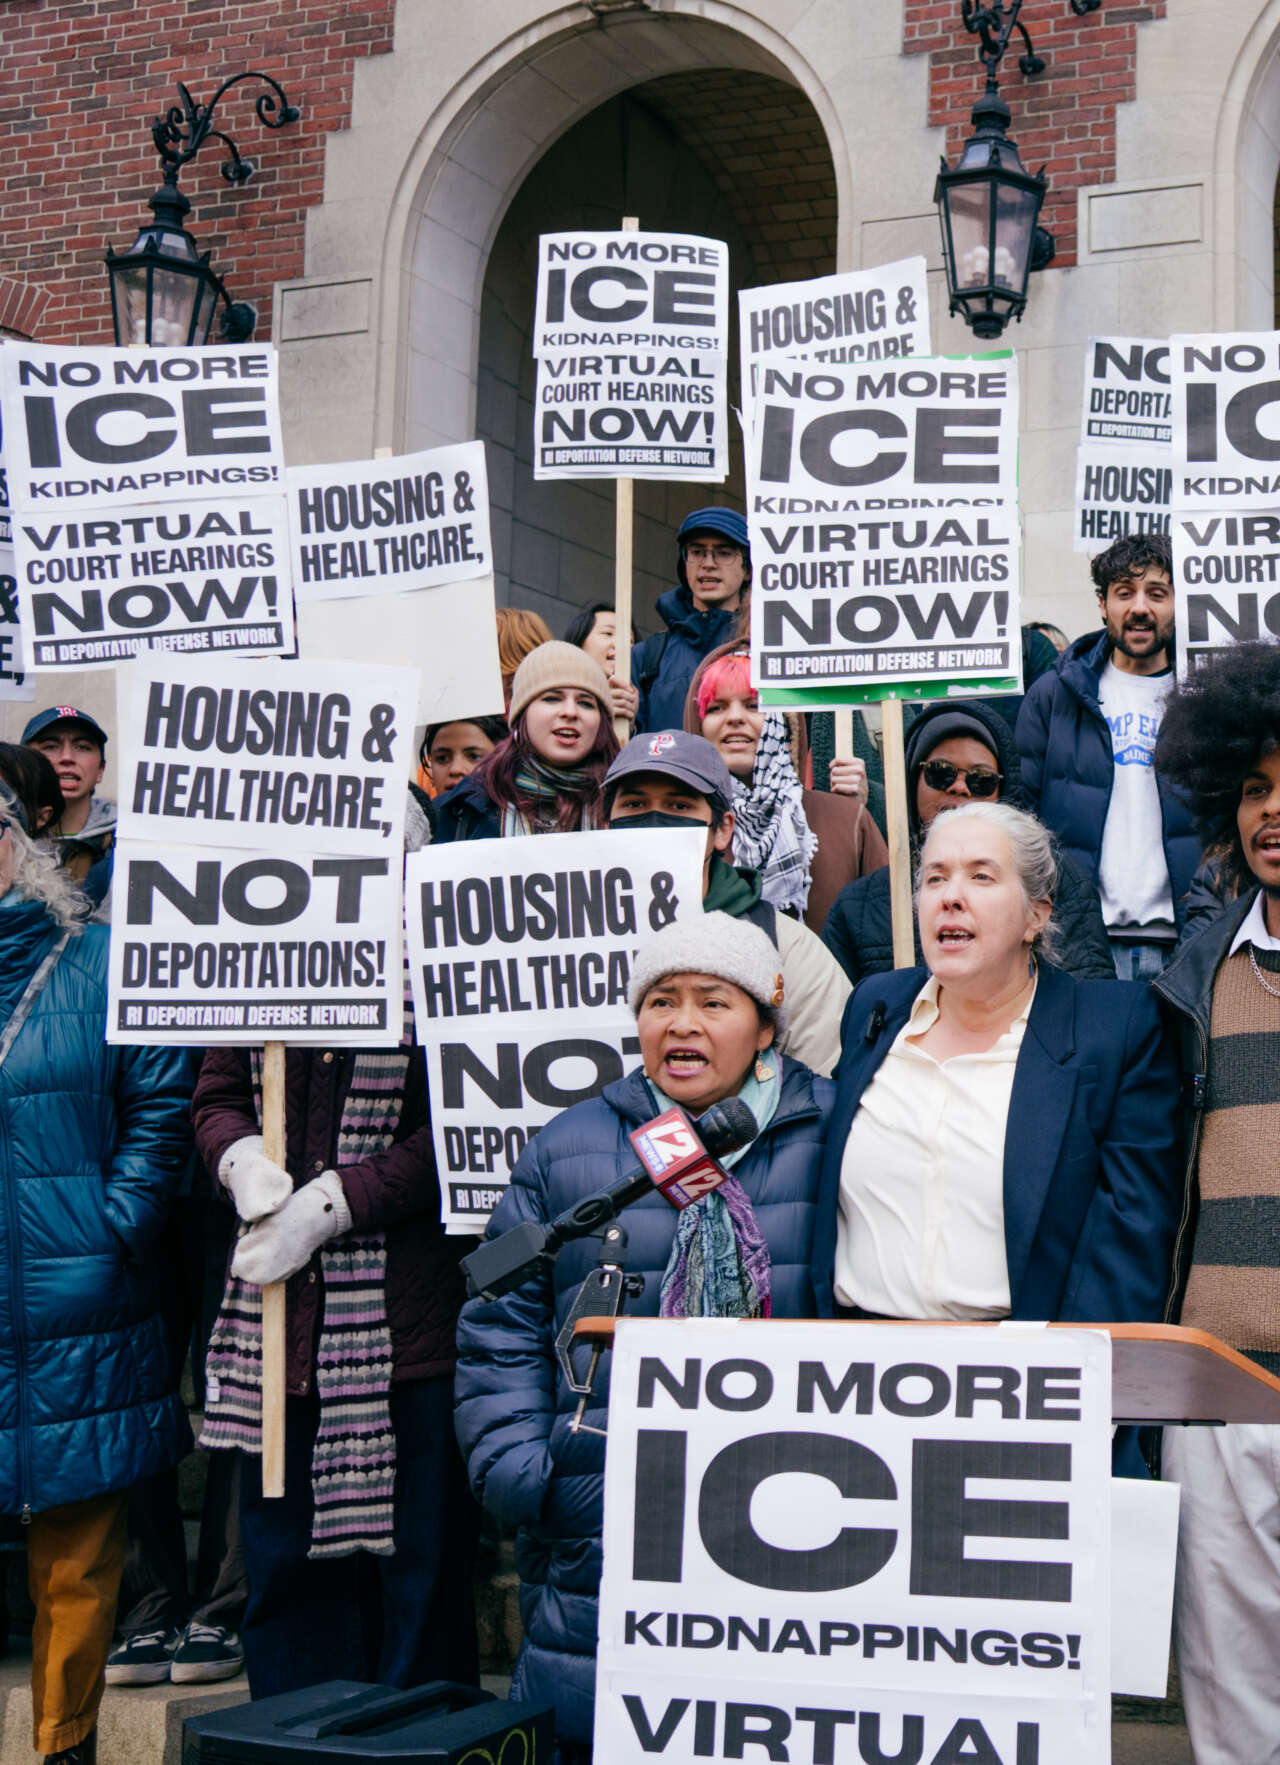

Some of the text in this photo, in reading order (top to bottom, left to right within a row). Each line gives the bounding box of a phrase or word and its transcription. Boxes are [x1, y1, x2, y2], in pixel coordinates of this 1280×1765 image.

[547, 241, 720, 268] NO MORE
[545, 266, 717, 327] ICE
[750, 285, 917, 353] HOUSING &
[542, 332, 720, 350] KIDNAPPINGS!
[1183, 345, 1266, 373] NO
[19, 354, 269, 388] NO MORE
[544, 355, 715, 379] VIRTUAL
[764, 368, 845, 402] NO
[856, 370, 1008, 401] MORE
[1093, 342, 1171, 385] NO
[542, 382, 714, 404] COURT HEARINGS
[1089, 388, 1172, 419] DEPORTA
[23, 386, 272, 469] ICE
[542, 407, 715, 444] NOW!
[759, 405, 1002, 487] ICE
[555, 449, 616, 464] DEPORTATION
[619, 449, 661, 463] DEFENSE
[663, 450, 710, 465] NETWORK
[29, 465, 279, 499] KIDNAPPINGS!
[298, 470, 475, 535] HOUSING &
[22, 510, 273, 551] VIRTUAL
[759, 519, 1010, 555] VIRTUAL
[26, 542, 275, 585] COURT HEARINGS
[300, 523, 484, 582] HEALTHCARE,
[760, 554, 1009, 592] COURT HEARINGS
[1183, 553, 1280, 584] COURT
[32, 575, 278, 635] NOW!
[763, 590, 1010, 647] NOW!
[41, 646, 56, 662] RI
[60, 637, 151, 661] DEPORTATION
[153, 631, 209, 651] DEFENSE
[212, 627, 277, 648] NETWORK
[767, 648, 1002, 675] RI DEPORTATION DEFENSE NETWORK
[144, 681, 398, 763] HOUSING &
[132, 761, 392, 838] HEALTHCARE,
[126, 857, 389, 926] NOT
[420, 867, 680, 949] HOUSING &
[122, 940, 386, 989] DEPORTATIONS!
[422, 949, 639, 1018] HEALTHCA
[127, 1005, 379, 1026] RI DEPORTATION DEFENSE NETWORK
[441, 1038, 641, 1109] NO
[646, 1121, 698, 1165] 12
[456, 1189, 469, 1209] RI
[676, 1167, 724, 1197] 12
[636, 1357, 1082, 1422] NO MORE
[632, 1428, 1073, 1603] ICE
[623, 1610, 1082, 1670] KIDNAPPINGS!
